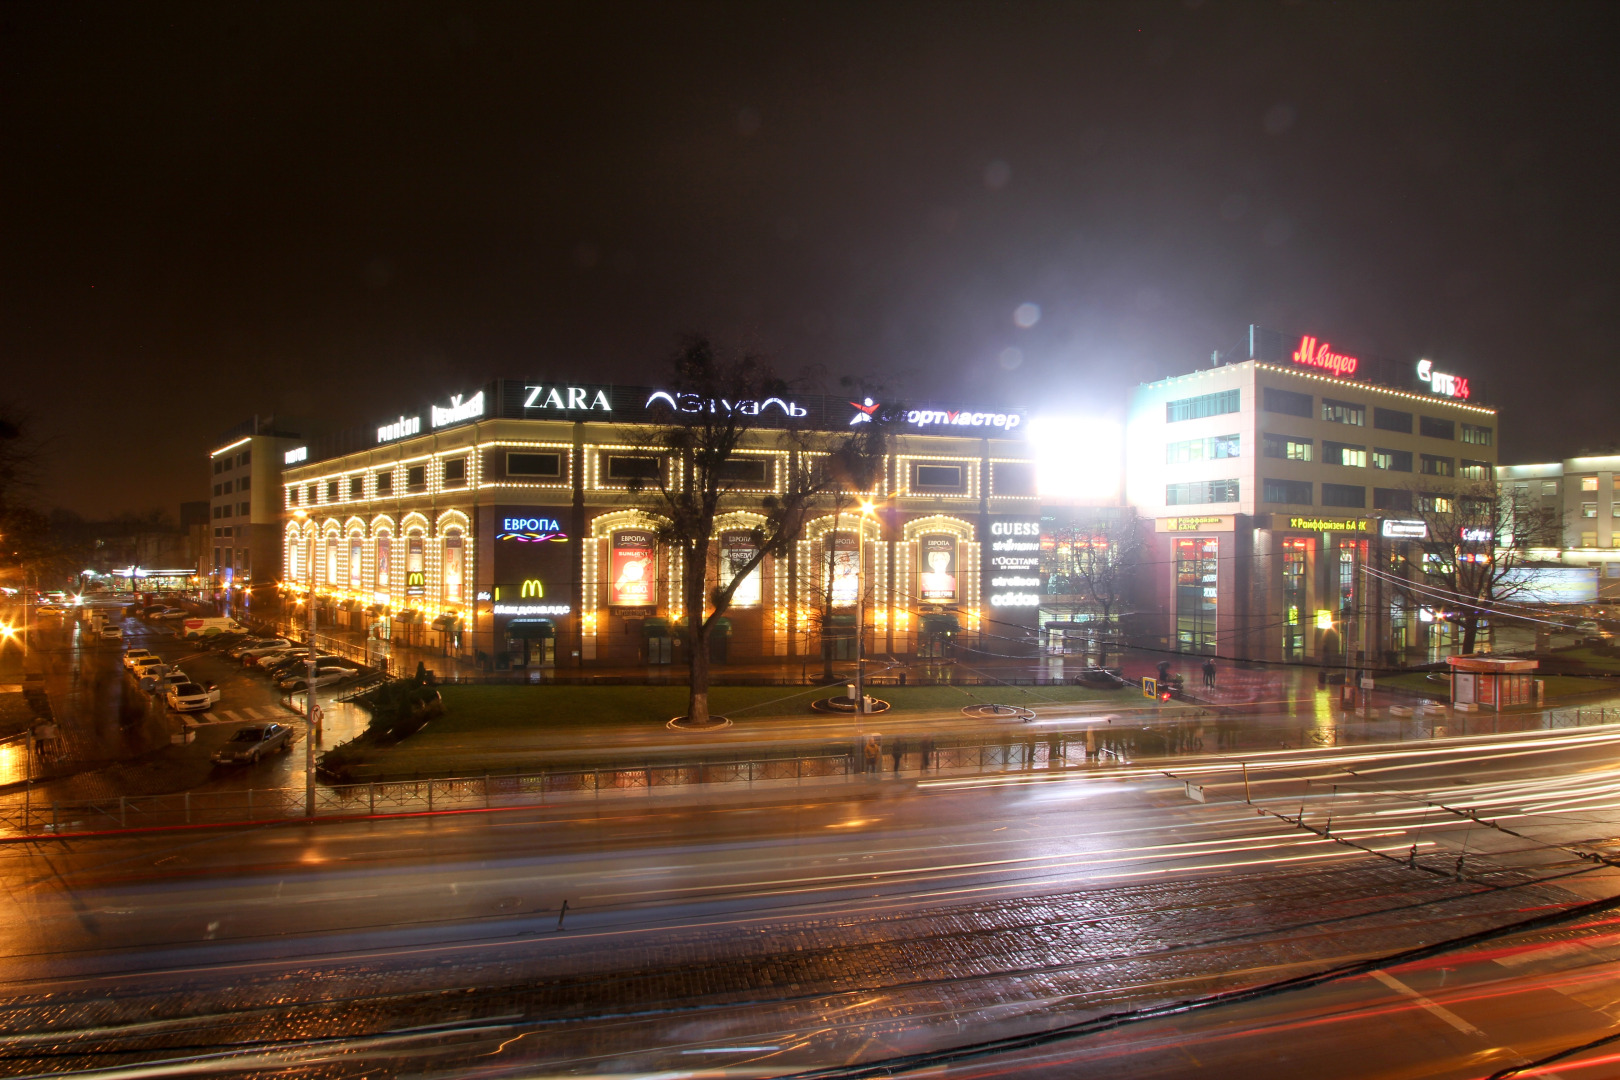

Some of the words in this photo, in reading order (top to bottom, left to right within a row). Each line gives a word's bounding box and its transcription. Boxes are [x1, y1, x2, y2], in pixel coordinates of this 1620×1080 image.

[1293, 336, 1358, 376] М.видео
[1432, 372, 1470, 398] ВТБ24
[524, 386, 612, 411] ZARA
[504, 518, 560, 531] ЕВРОПА
[991, 522, 1040, 535] GUESS
[1297, 519, 1345, 531] Райффайзен
[991, 591, 1040, 606] adidas
